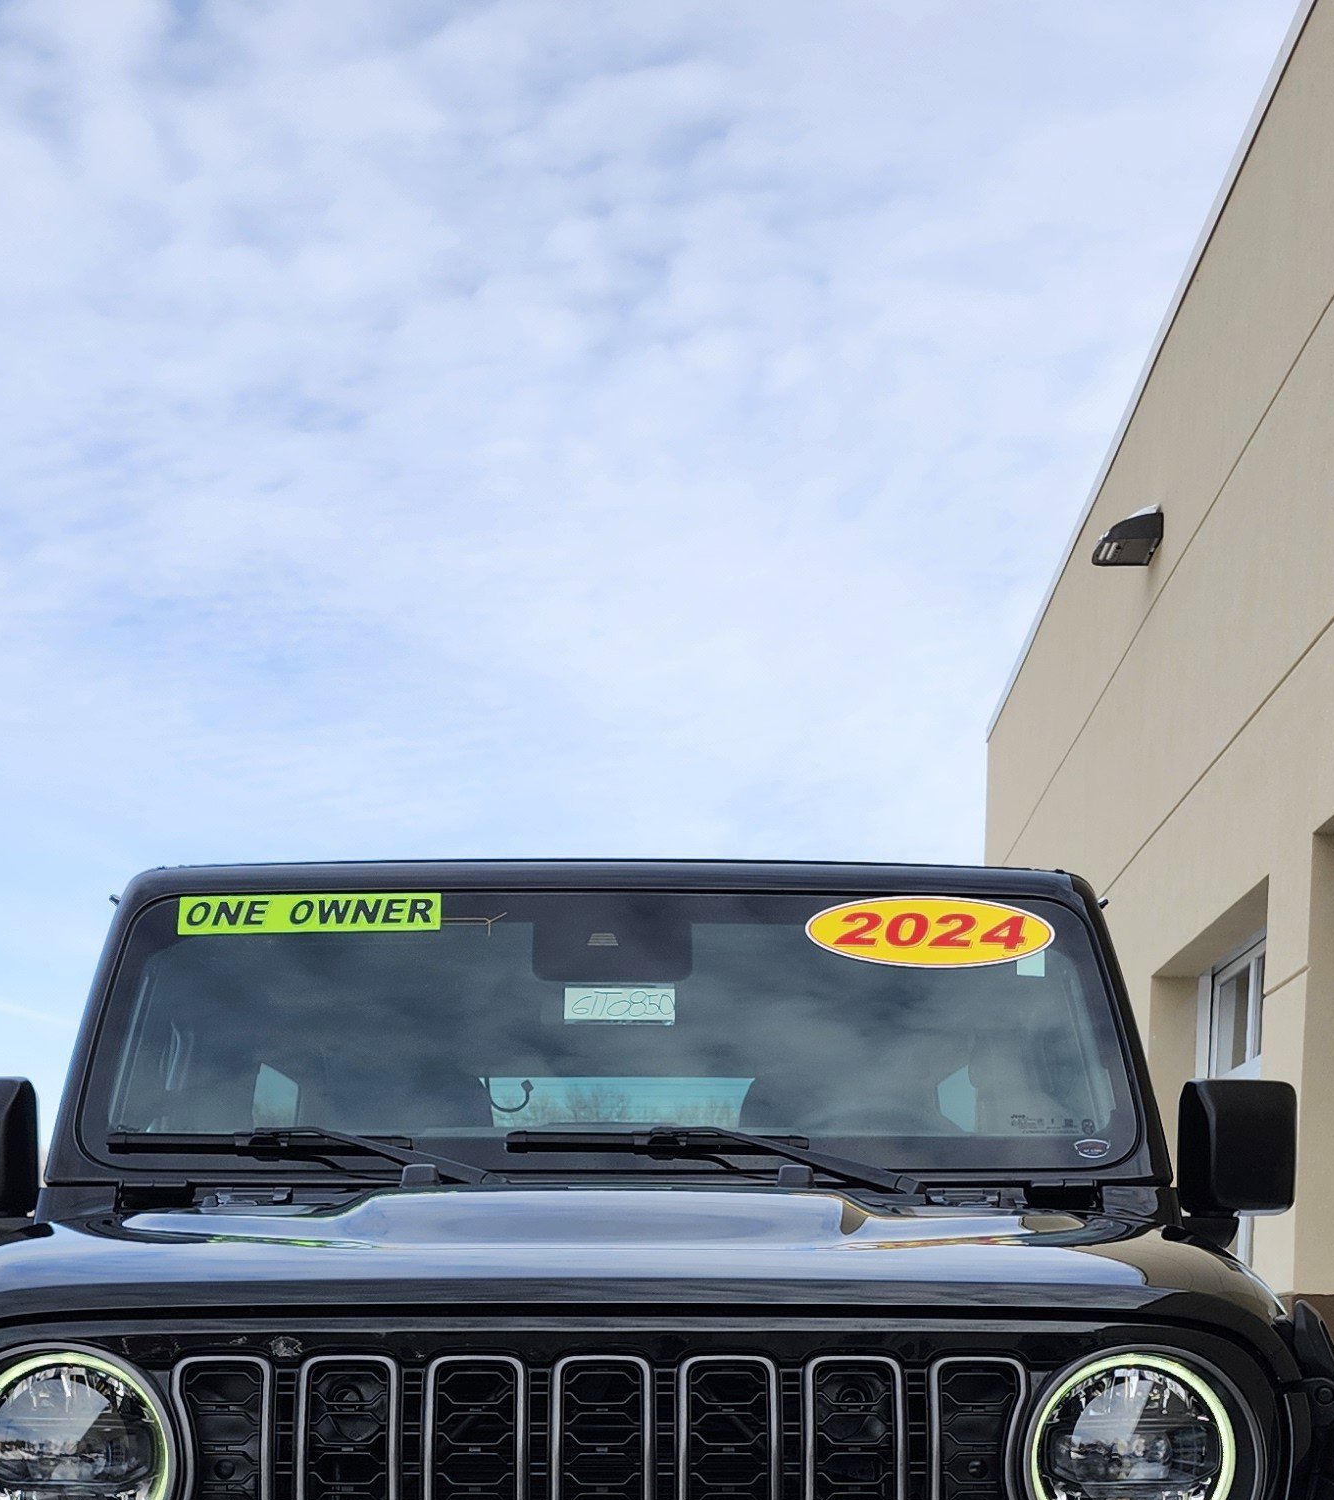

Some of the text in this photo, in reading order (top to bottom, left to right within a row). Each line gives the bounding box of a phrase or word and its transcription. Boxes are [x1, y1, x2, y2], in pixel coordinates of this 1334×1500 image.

[185, 898, 436, 927] ONE OWNER
[832, 911, 1028, 953] 2024
